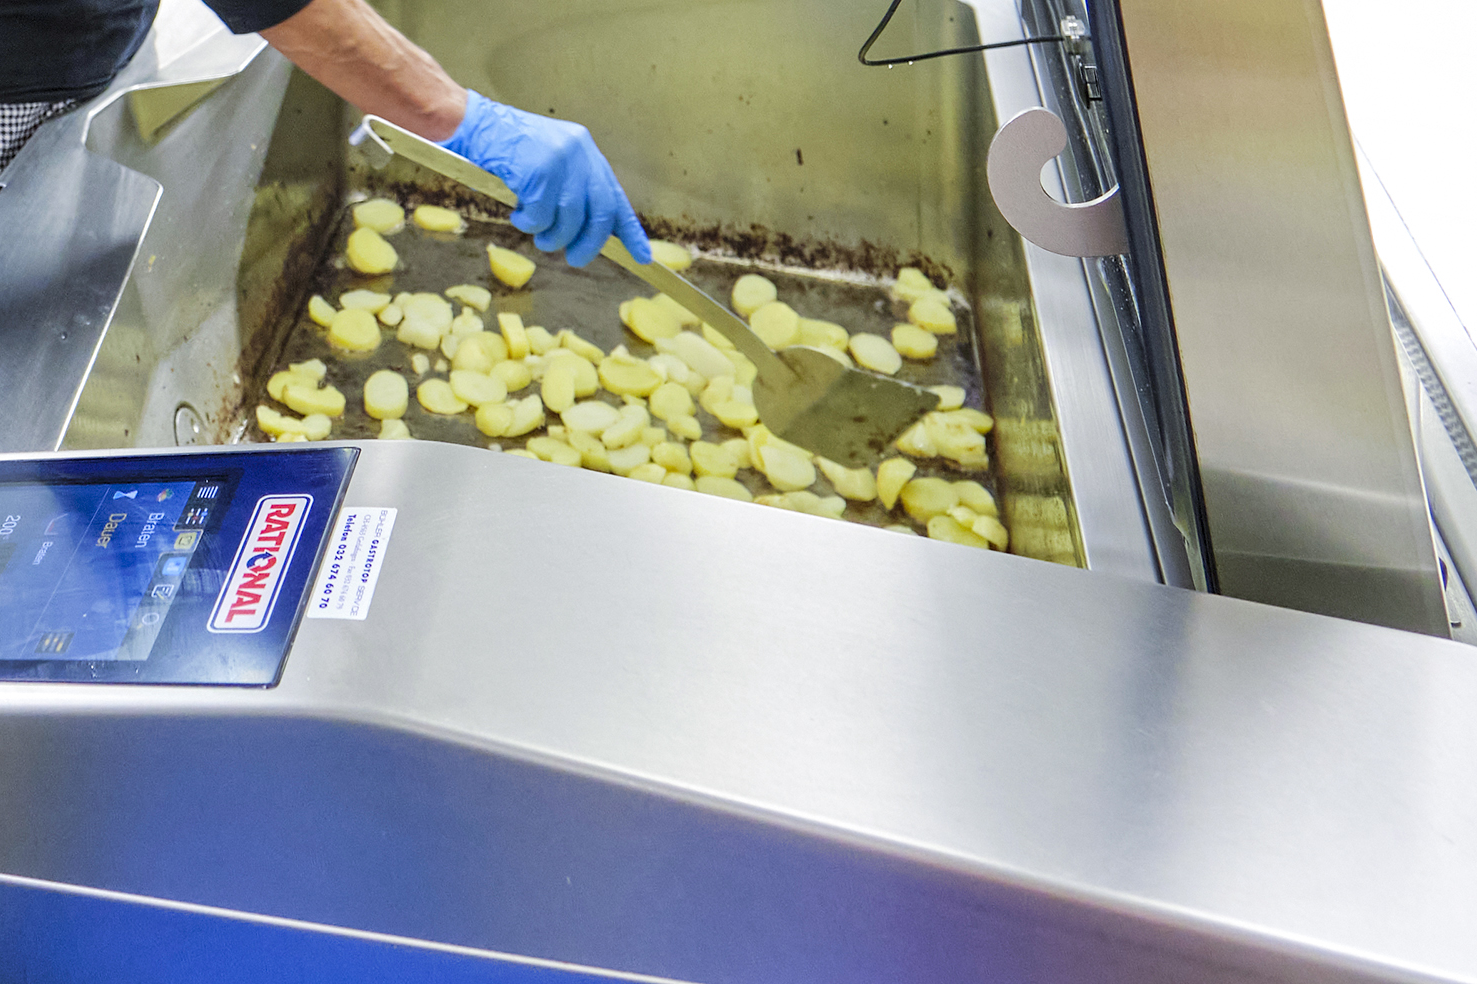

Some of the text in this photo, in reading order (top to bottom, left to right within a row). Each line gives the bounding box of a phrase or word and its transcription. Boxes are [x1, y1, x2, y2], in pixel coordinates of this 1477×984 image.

[95, 513, 127, 549] Dauer
[134, 512, 165, 548] Braten
[32, 541, 53, 565] Braten
[224, 503, 297, 623] RATIONAL
[319, 513, 357, 609] Telefon 032 674 60 70
[361, 539, 380, 583] GASTROTOP
